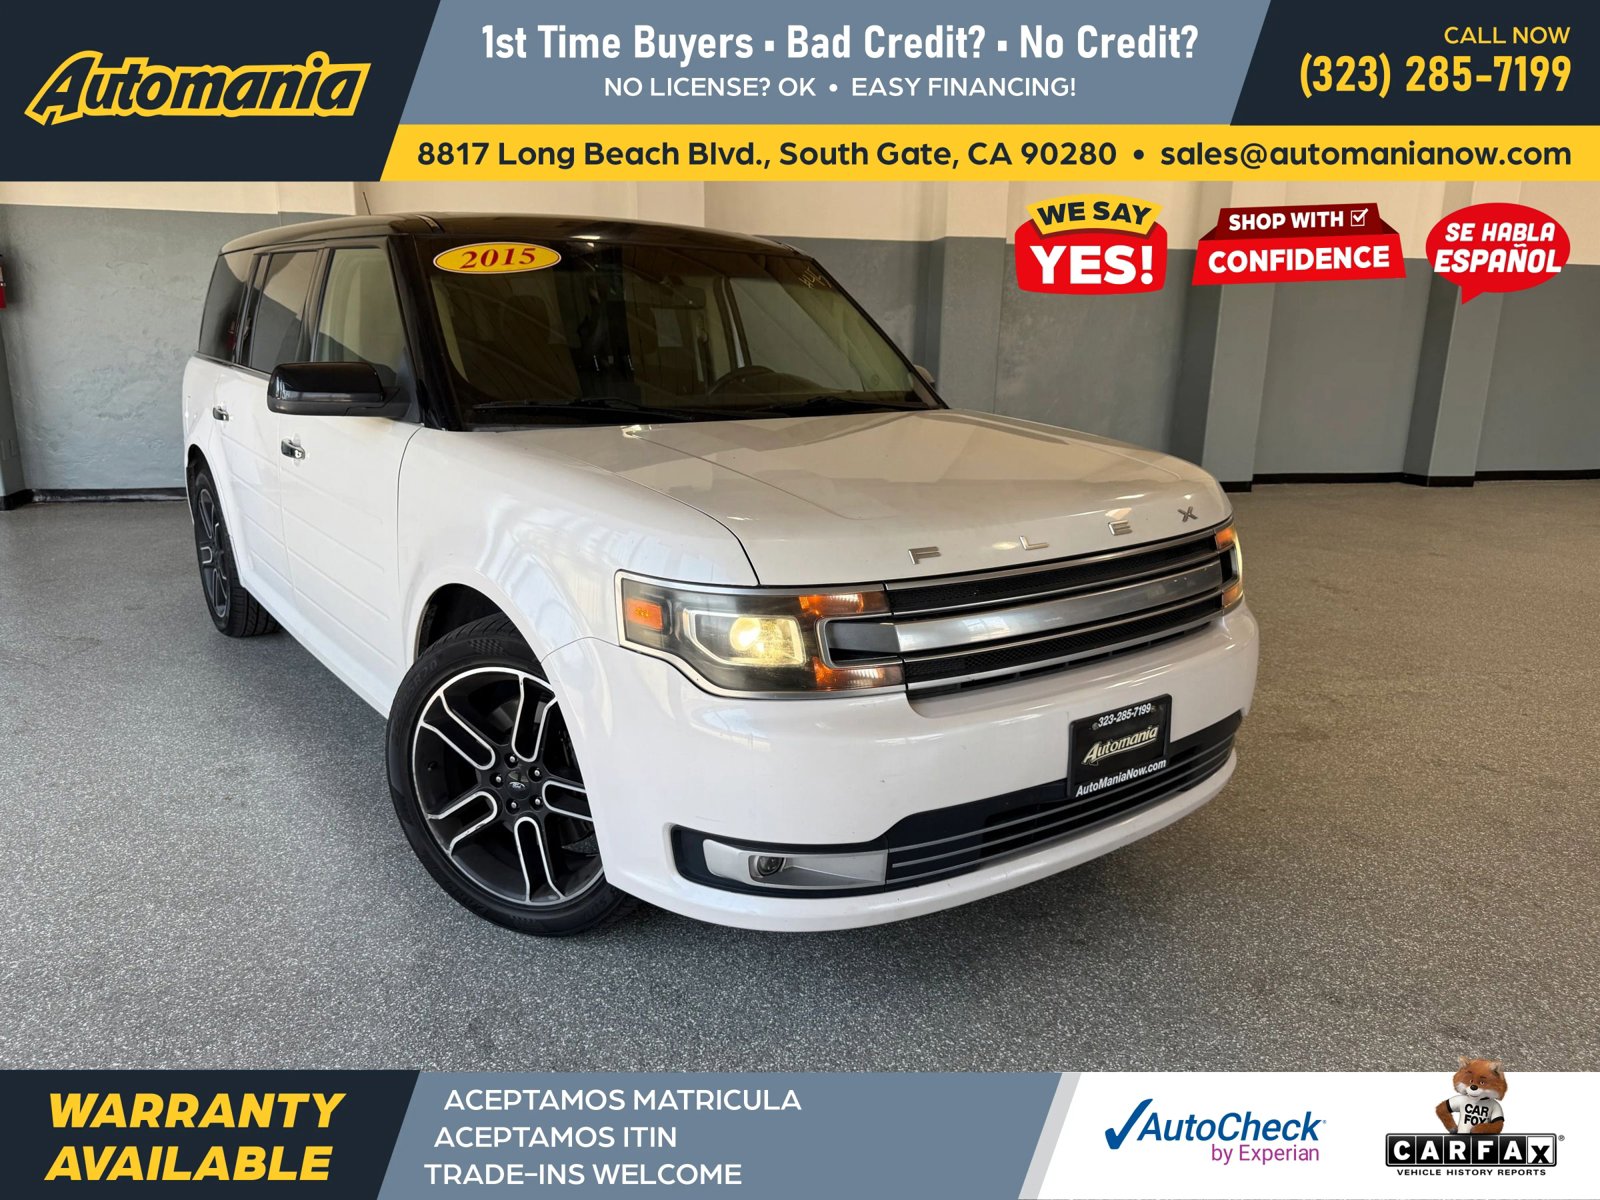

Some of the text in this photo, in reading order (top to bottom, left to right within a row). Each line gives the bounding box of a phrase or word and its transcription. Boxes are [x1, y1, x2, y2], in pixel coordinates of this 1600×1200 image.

[459, 247, 536, 269] 2015
[1097, 702, 1152, 728] 323-285-7199
[1082, 725, 1160, 764] Automania
[1075, 759, 1167, 798] AutoManiaNow.com
